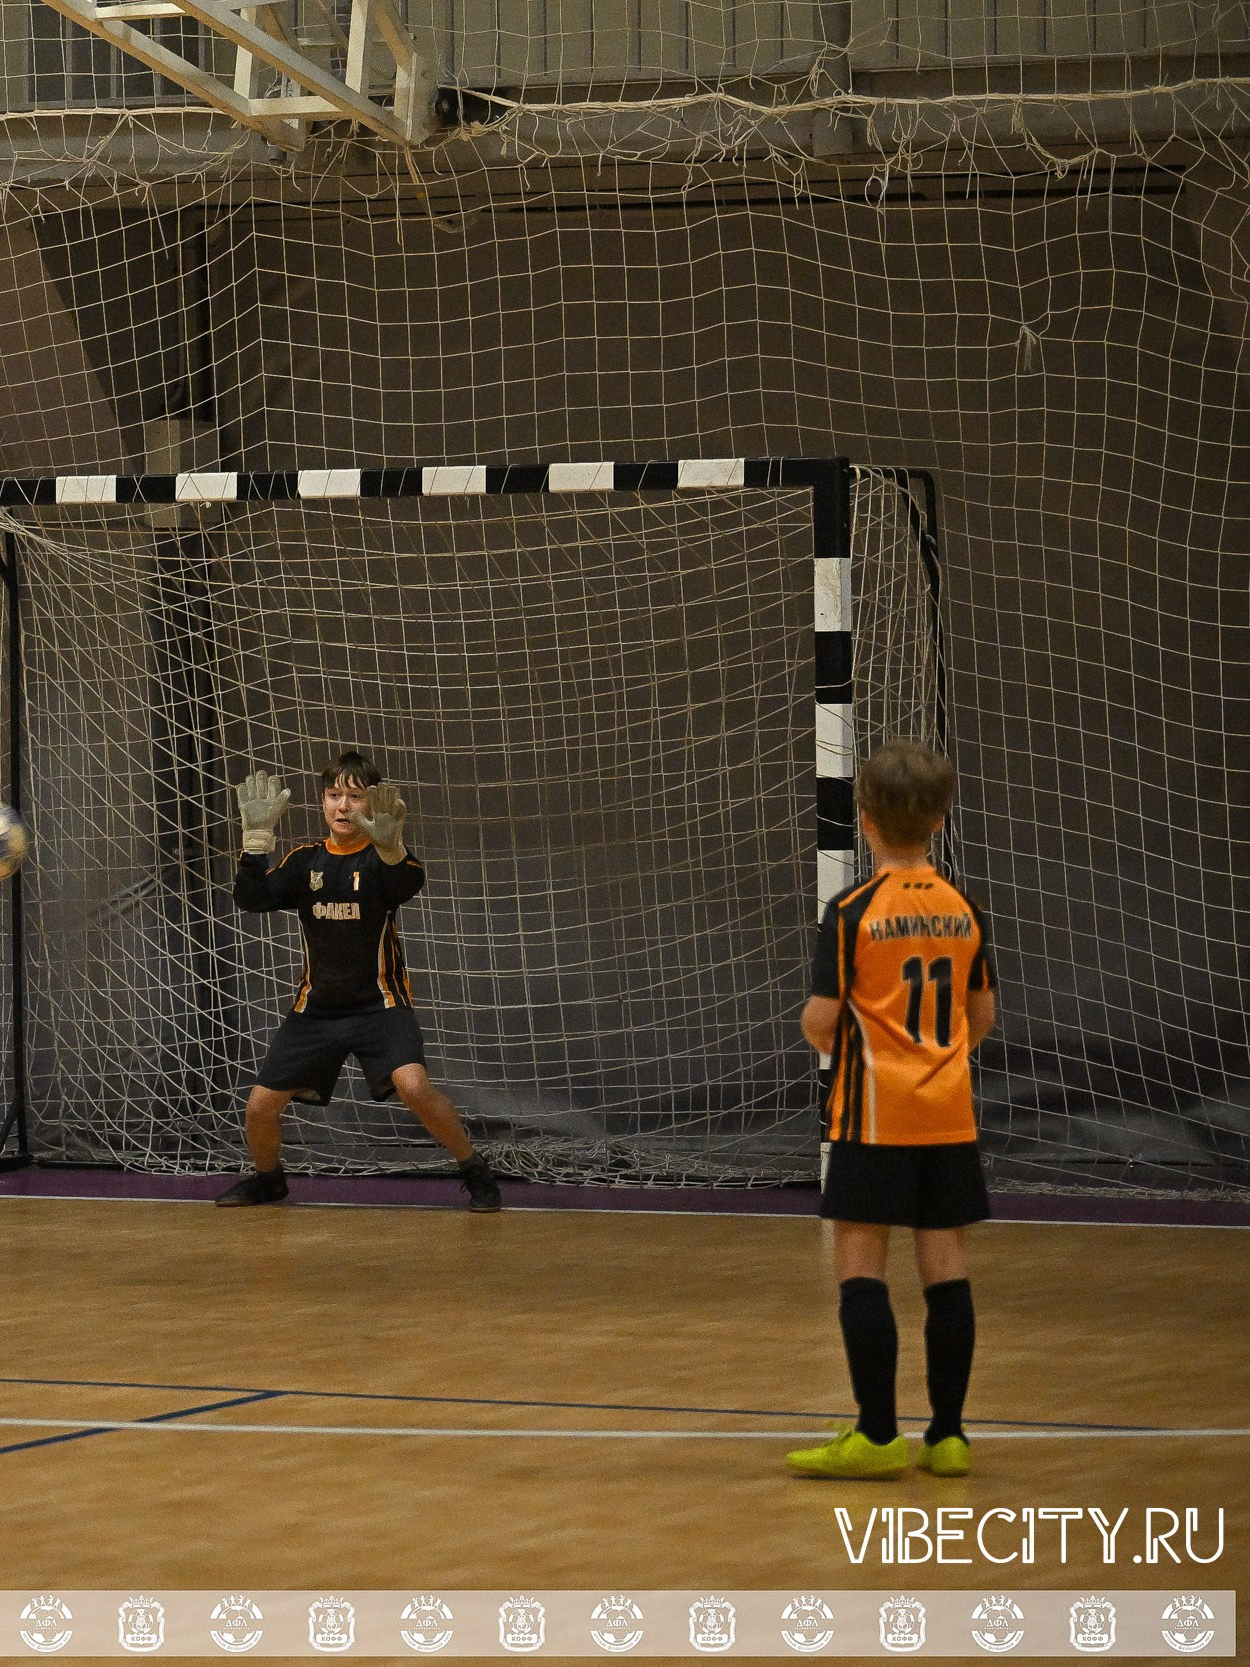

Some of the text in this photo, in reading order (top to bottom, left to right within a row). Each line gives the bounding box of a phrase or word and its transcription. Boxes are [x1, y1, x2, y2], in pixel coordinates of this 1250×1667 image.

[352, 871, 361, 891] 1
[312, 901, 361, 920] ФАКЕЛ
[902, 955, 954, 1047] 11
